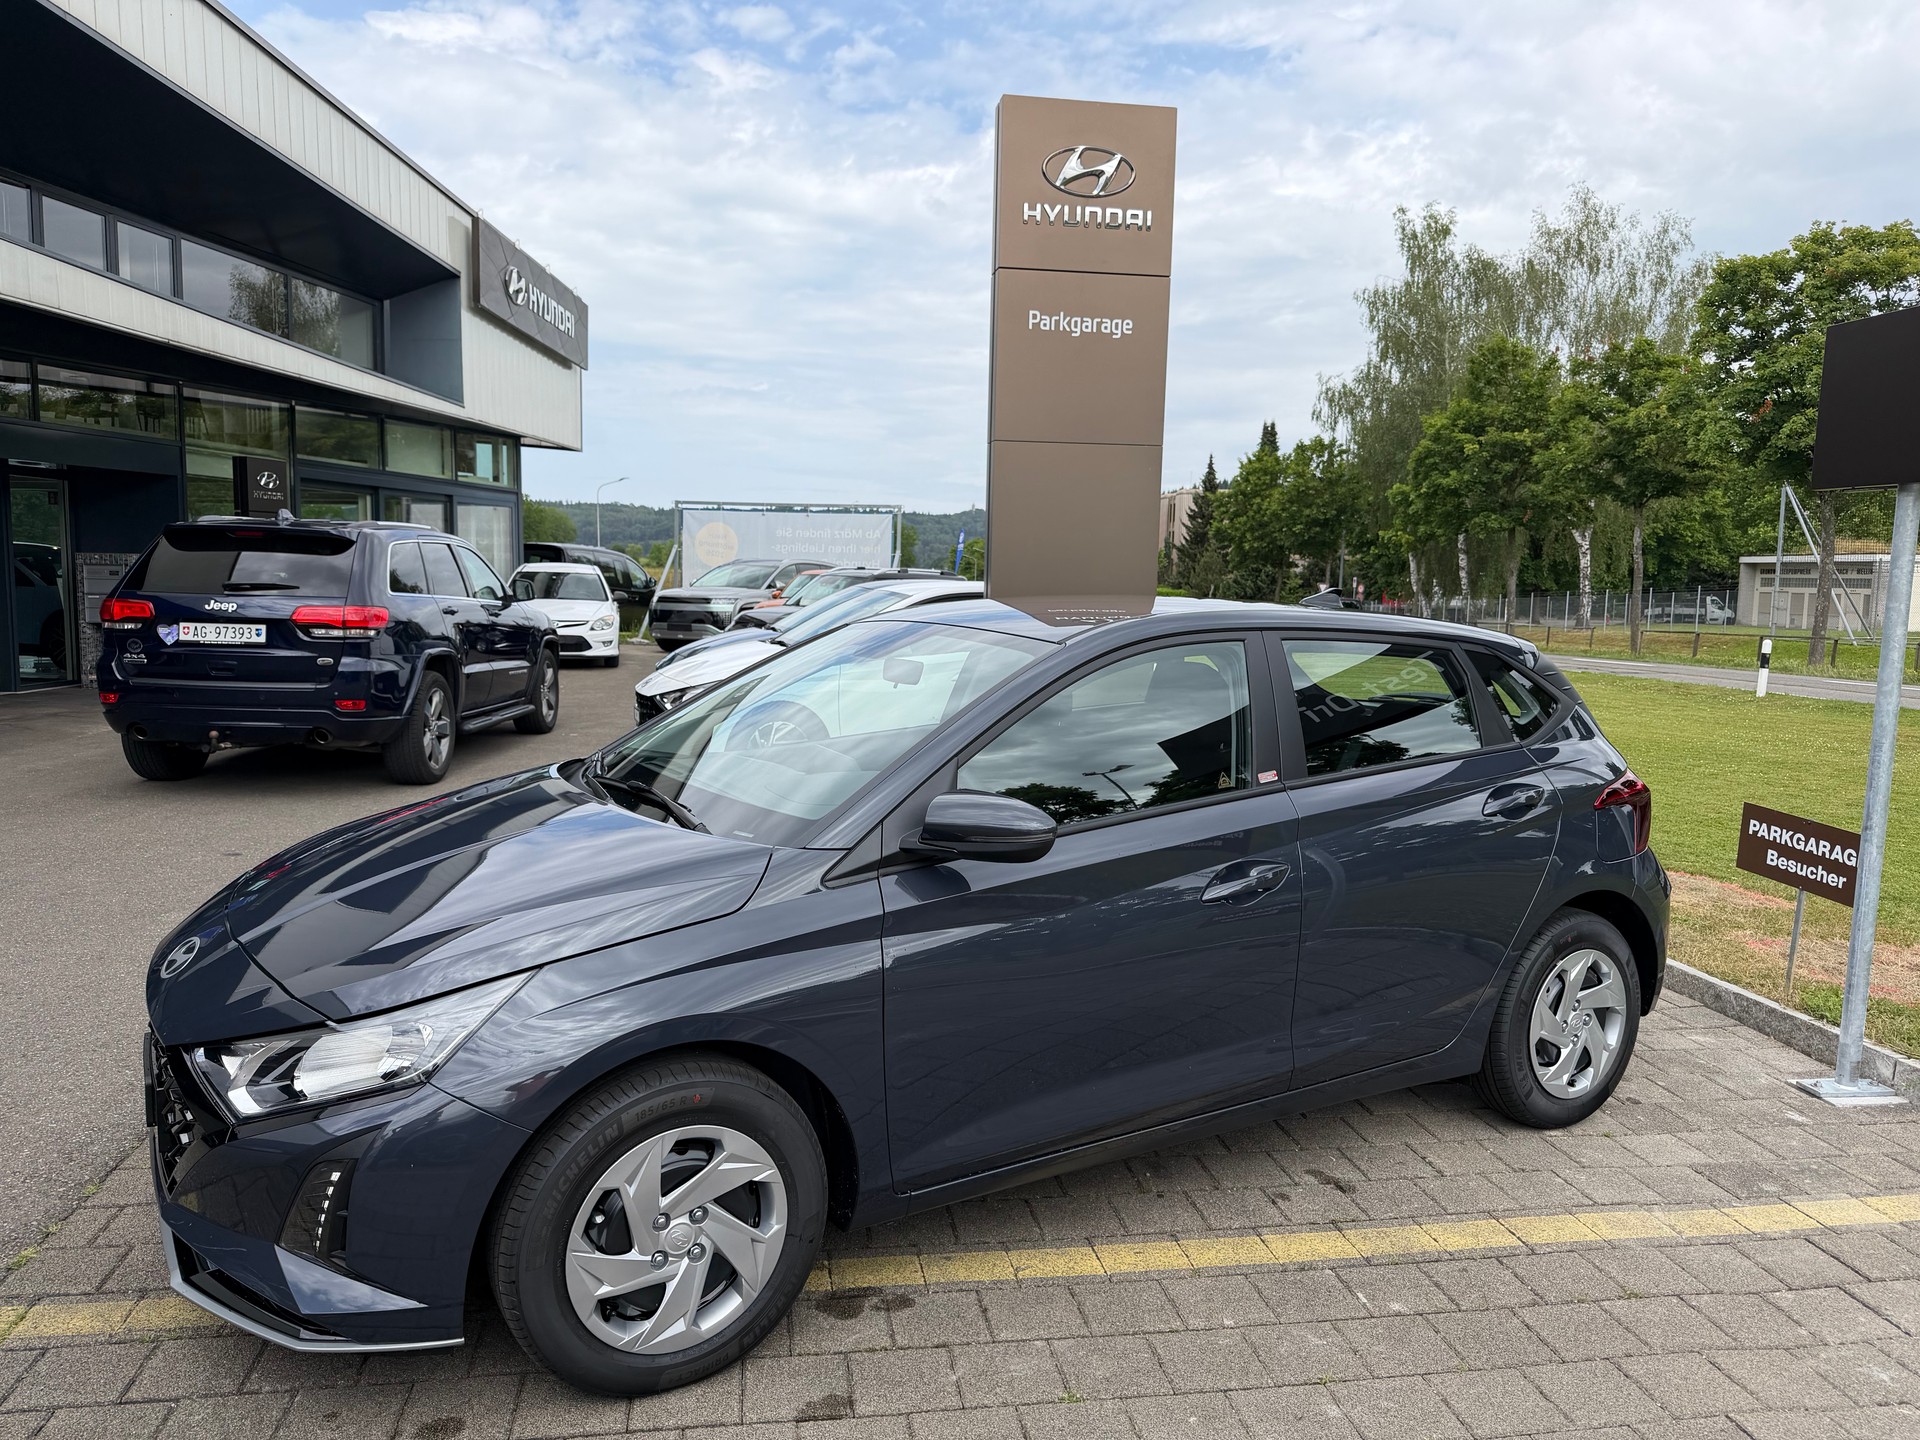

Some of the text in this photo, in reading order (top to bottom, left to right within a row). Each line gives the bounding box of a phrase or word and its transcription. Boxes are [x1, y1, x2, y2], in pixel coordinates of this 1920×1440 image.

[1023, 202, 1153, 231] HYUNDAI
[528, 283, 575, 338] HYUNDAI
[1028, 310, 1133, 338] Parkgarage
[204, 600, 238, 613] Jeep
[1748, 819, 1859, 868] PARKGARAG
[1766, 848, 1847, 889] Besucher
[543, 1121, 621, 1220] MICHELIN
